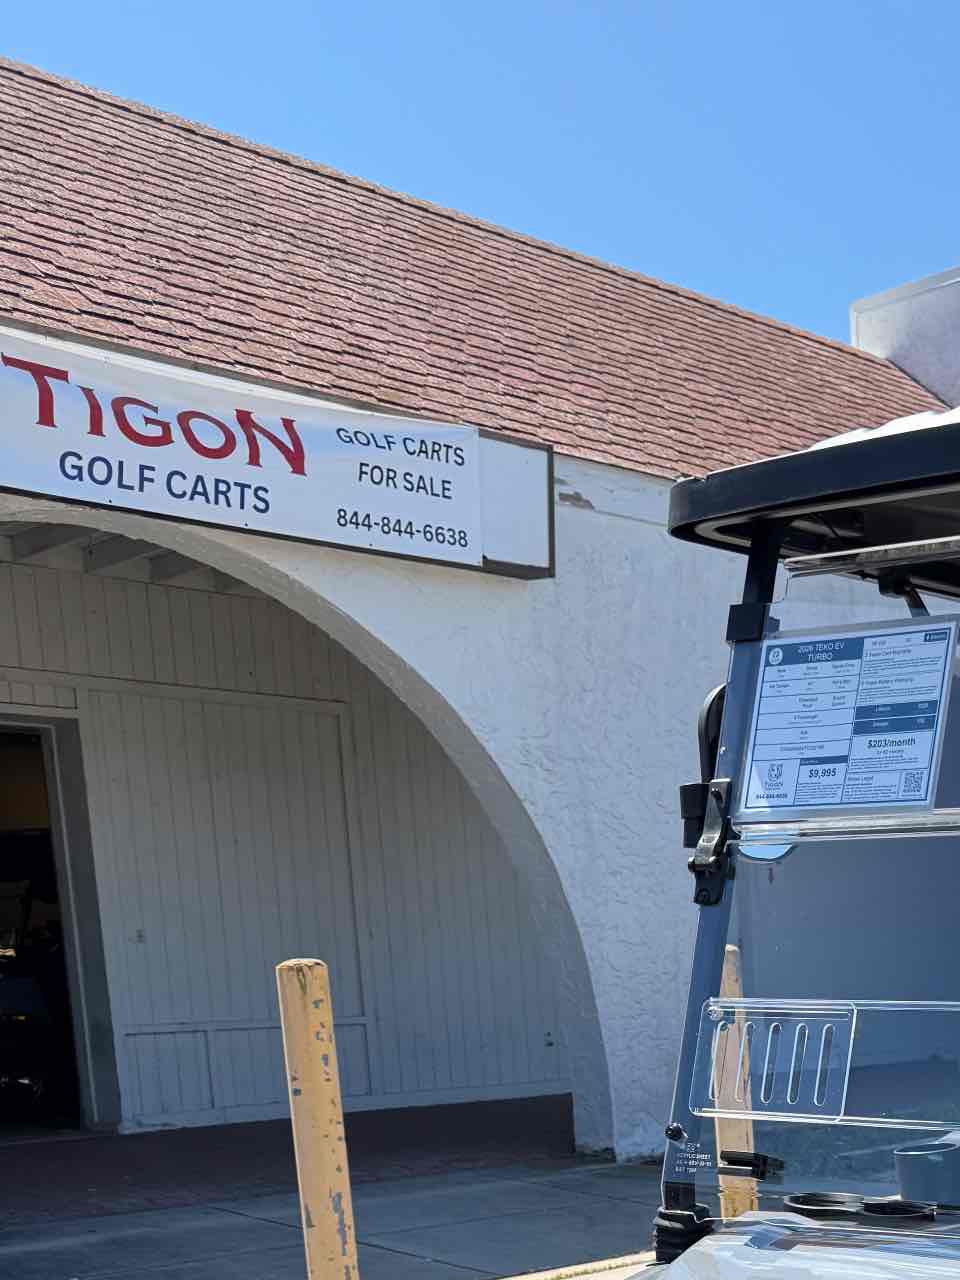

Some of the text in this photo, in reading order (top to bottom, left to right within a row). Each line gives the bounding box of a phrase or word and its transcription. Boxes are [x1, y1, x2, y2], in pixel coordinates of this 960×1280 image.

[1, 352, 307, 476] TIGON
[336, 427, 466, 466] GOLF CARTS
[59, 451, 271, 514] GOLF CARTS
[358, 462, 453, 500] FOR SALE
[336, 508, 469, 548] 844-844-6638
[867, 736, 916, 749] $203/month
[808, 767, 837, 780] $9,995
